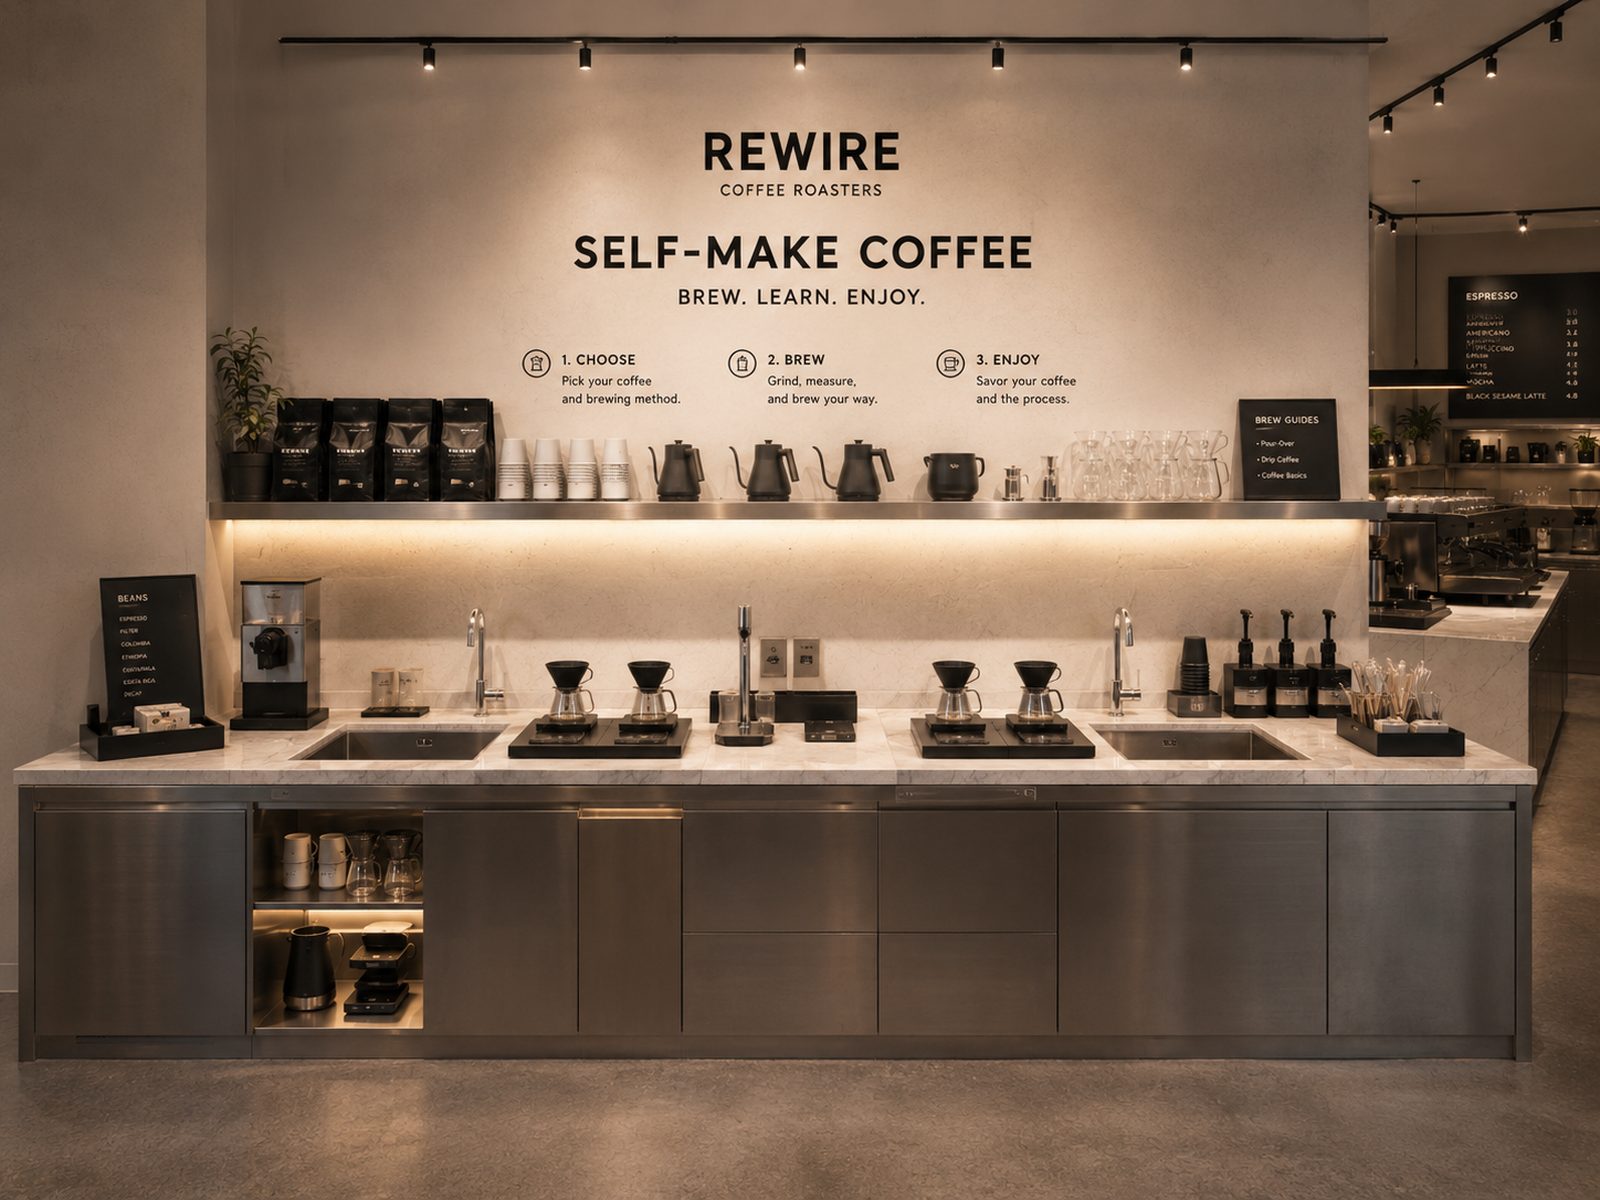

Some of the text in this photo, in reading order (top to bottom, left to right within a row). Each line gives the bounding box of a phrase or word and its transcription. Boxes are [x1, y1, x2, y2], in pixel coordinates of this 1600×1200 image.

[704, 131, 900, 171] REWIRE
[720, 183, 882, 197] COFFEE ROASTERS
[574, 235, 1033, 270] SELF-MAKE COFFEE
[678, 289, 925, 306] BREW. LEARN. ENJOY.
[1466, 291, 1518, 301] ESPRESSO
[562, 354, 636, 366] 1. CHOOSE
[767, 354, 825, 366] 2. BREW
[976, 354, 1040, 366] 3. ENJOY
[562, 375, 652, 390] Pick your coffee
[767, 375, 857, 388] Grind, measure,
[976, 375, 1077, 390] Savor your coffee
[562, 393, 681, 408] and brewing method.
[767, 393, 878, 408] and brew your way.
[976, 393, 1070, 408] and the process.
[1466, 392, 1546, 400] BLACK SESAME LATTE
[1255, 416, 1319, 424] BREW GUIDES
[1261, 456, 1275, 464] Drip
[117, 593, 149, 603] BEANS
